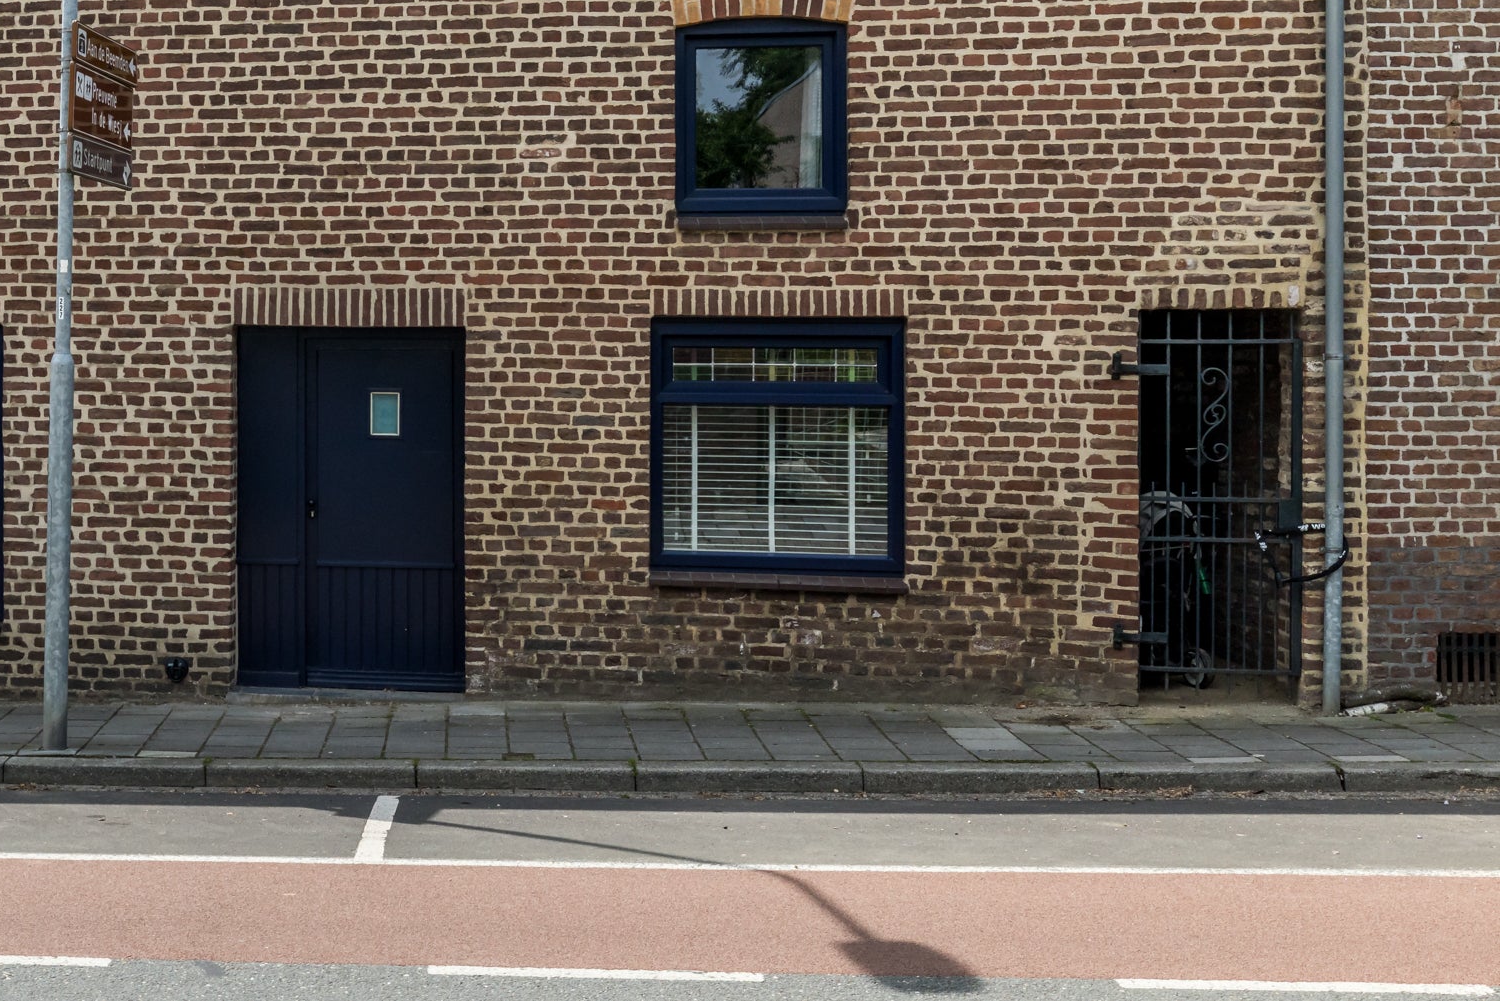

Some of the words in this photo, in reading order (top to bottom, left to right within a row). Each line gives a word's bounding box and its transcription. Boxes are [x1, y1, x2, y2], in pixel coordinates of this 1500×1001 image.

[87, 38, 98, 59] Aan
[98, 44, 106, 62] de
[106, 46, 130, 73] Beemden
[91, 106, 98, 126] In
[99, 111, 106, 129] de
[83, 148, 113, 174] Startpunt
